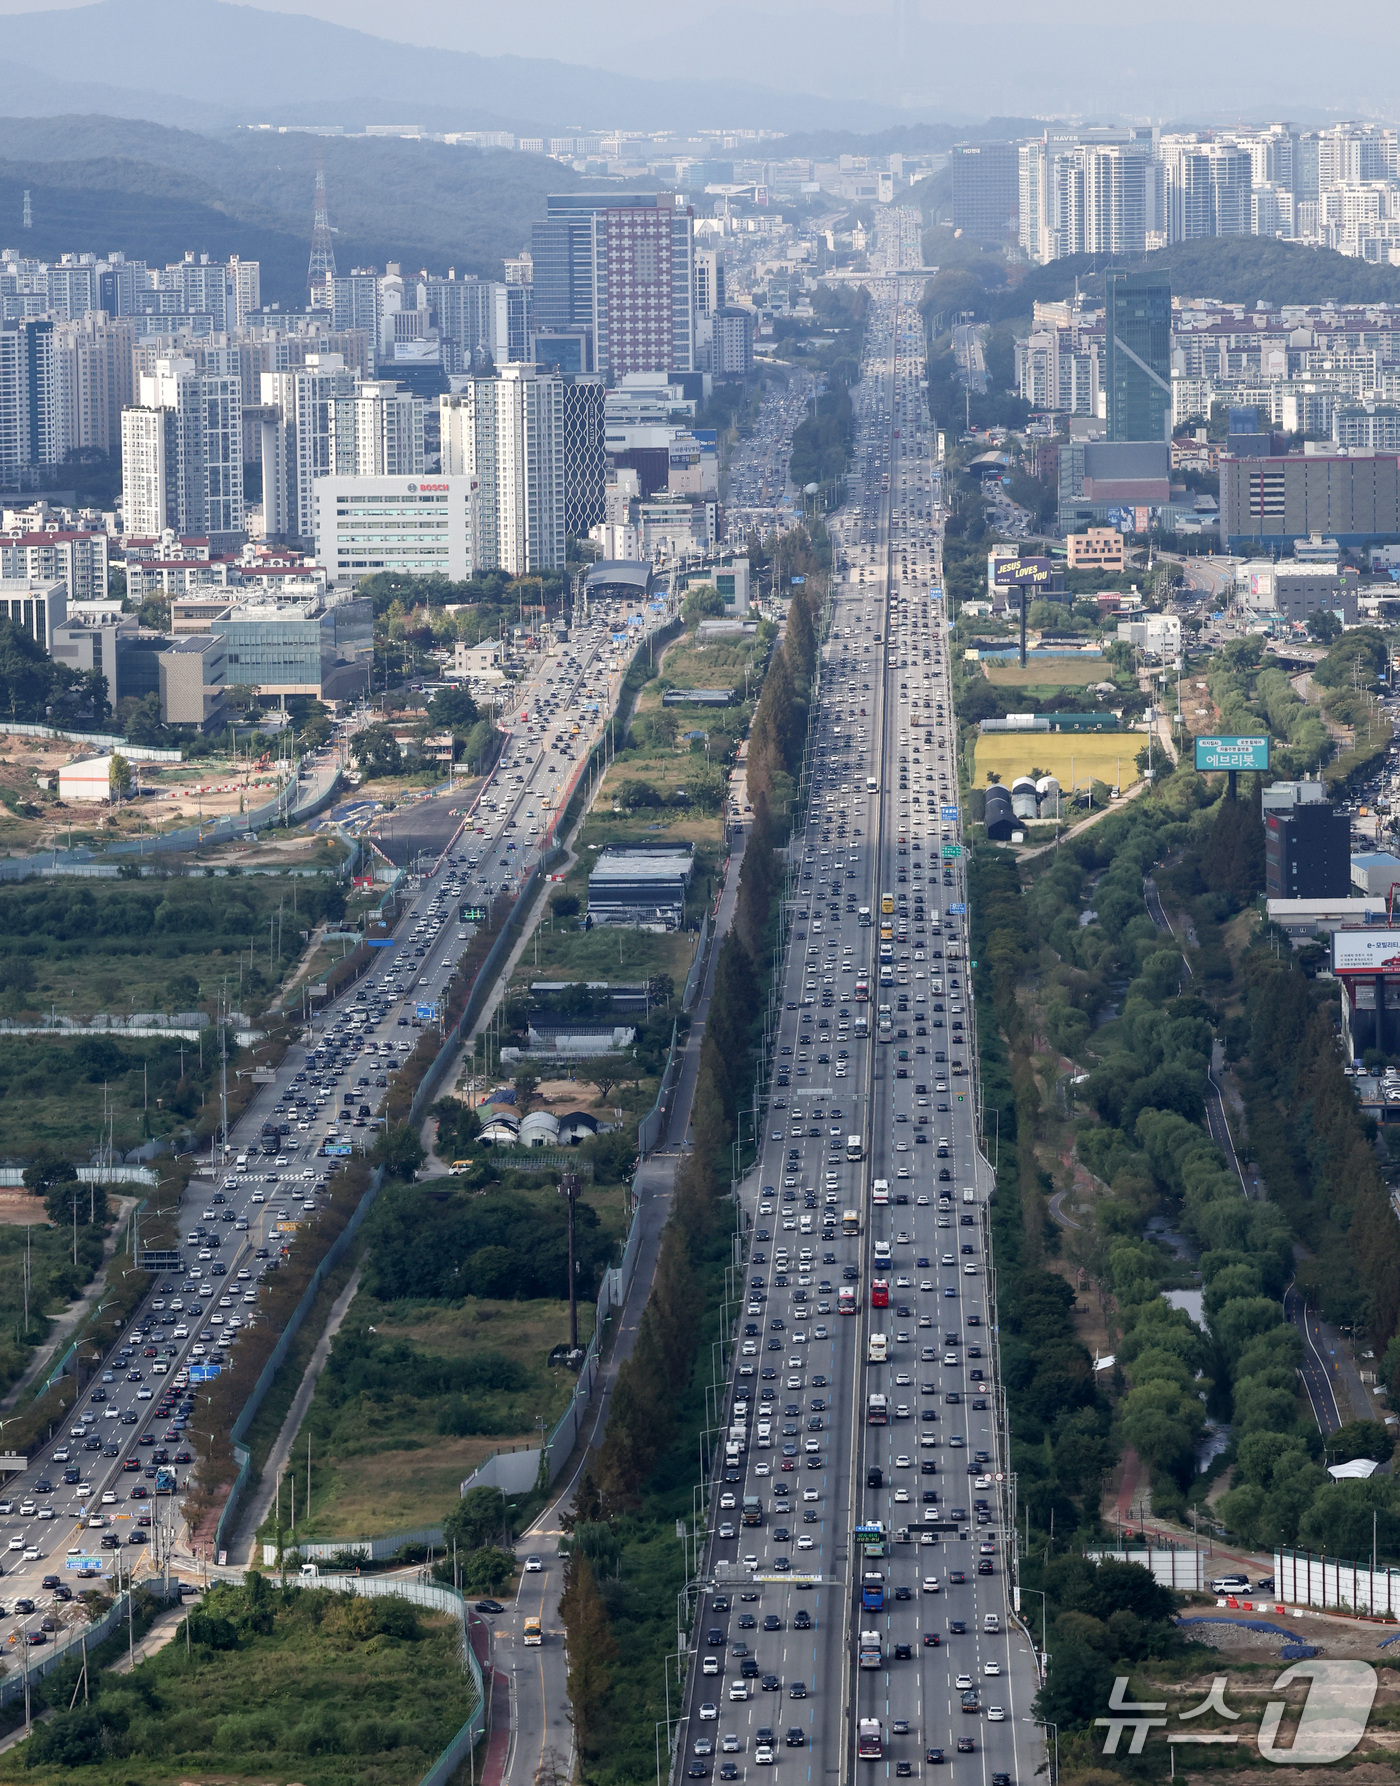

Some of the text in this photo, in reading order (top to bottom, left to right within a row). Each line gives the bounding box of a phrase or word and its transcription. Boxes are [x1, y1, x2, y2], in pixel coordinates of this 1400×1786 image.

[997, 560, 1021, 574] JESUS
[1015, 565, 1038, 578] LOVES
[1033, 571, 1048, 582] YOU
